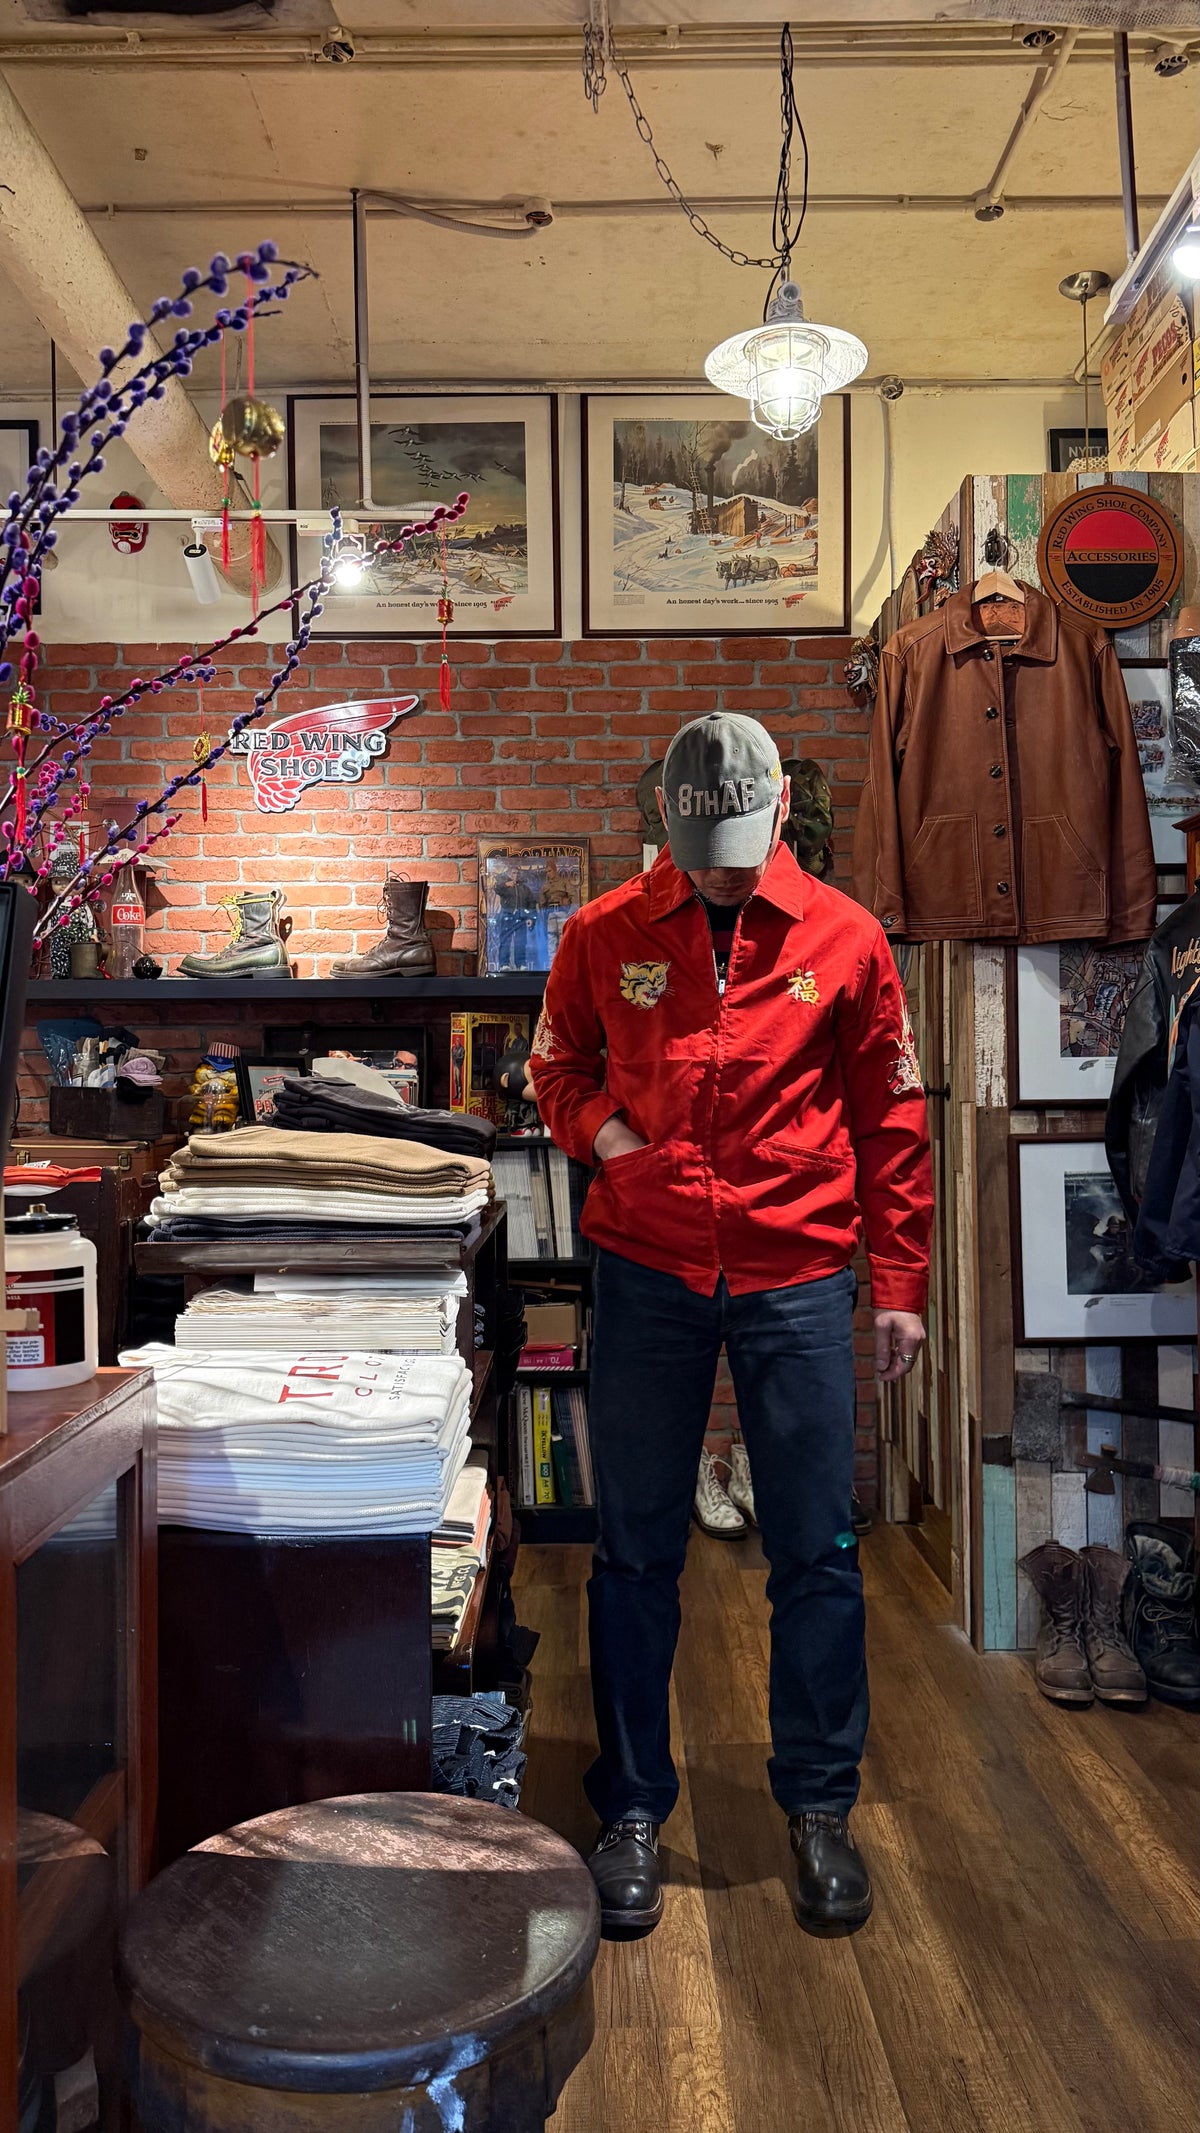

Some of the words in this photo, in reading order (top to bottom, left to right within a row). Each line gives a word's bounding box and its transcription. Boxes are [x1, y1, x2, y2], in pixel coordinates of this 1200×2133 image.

[1151, 320, 1178, 368] PECOS
[1052, 526, 1068, 549] RED
[1064, 503, 1095, 525] WING
[1096, 498, 1127, 509] SHOE
[1130, 503, 1168, 549] COMPANY
[1067, 551, 1157, 562] ACCESSORIES
[411, 601, 429, 610] day's
[702, 597, 720, 606] day's
[1061, 580, 1128, 615] ESTABLISHED
[1130, 601, 1144, 611] IN
[1144, 578, 1165, 601] 1905
[232, 731, 291, 750] RED
[299, 731, 386, 752] WING
[259, 757, 360, 778] SHOES
[117, 906, 141, 921] Coke
[786, 967, 820, 1004] 福
[550, 1355, 560, 1365] 70
